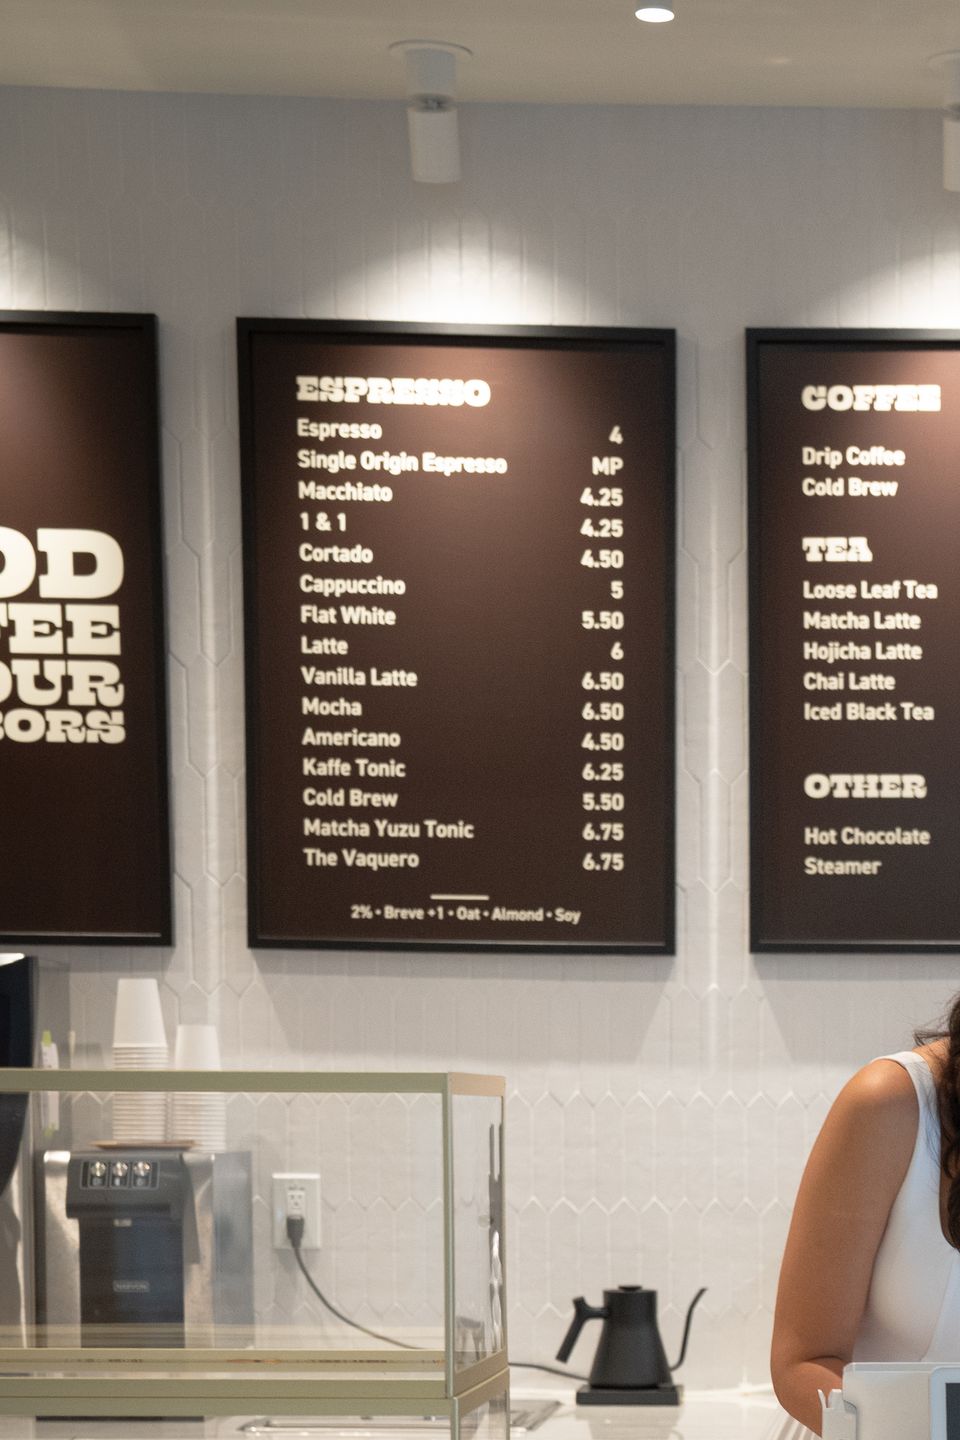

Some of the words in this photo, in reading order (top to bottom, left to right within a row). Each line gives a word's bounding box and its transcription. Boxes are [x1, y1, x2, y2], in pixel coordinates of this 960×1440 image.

[297, 376, 492, 408] ESPRESSO
[802, 384, 942, 411] COFFEE
[297, 418, 383, 442] Espresso
[609, 426, 623, 444] 4
[297, 449, 357, 474] Single
[359, 450, 420, 476] Origin
[421, 451, 509, 478] Espresso
[591, 456, 624, 476] MP
[802, 446, 843, 470] Drip
[845, 446, 907, 467] Coffee
[298, 481, 394, 503] Macchiato
[802, 477, 845, 497] Cold
[847, 476, 899, 497] Brew
[579, 487, 624, 507] 4.25
[300, 512, 309, 531] 1
[315, 511, 332, 531] &
[336, 512, 347, 532] 1
[580, 518, 624, 538] 4.25
[299, 543, 374, 564] Cortado
[580, 549, 624, 569] 4.50
[802, 536, 874, 563] TEA
[300, 574, 406, 598] Cappuccino
[610, 580, 624, 600] 5
[803, 580, 858, 599] Loose
[860, 579, 902, 600] Leaf
[902, 579, 939, 600] Tea
[300, 604, 337, 624] Flat
[340, 605, 397, 626] White
[581, 610, 624, 630] 5.50
[803, 611, 871, 630] Matcha
[873, 610, 922, 630] Latte
[0, 603, 121, 655] EE
[301, 635, 349, 655] Latte
[610, 642, 624, 660] 6
[803, 641, 872, 664] Hojicha
[875, 641, 923, 660] Latte
[0, 659, 124, 707] UR
[301, 666, 366, 686] Vanilla
[370, 667, 418, 687] Latte
[581, 672, 624, 691] 6.50
[803, 672, 845, 690] Chai
[848, 672, 896, 691] Latte
[302, 697, 362, 716] Mocha
[581, 702, 624, 721] 6.50
[804, 702, 842, 721] Iced
[846, 702, 897, 721] Black
[900, 702, 935, 721] Tea
[0, 708, 126, 744] ORS
[302, 727, 401, 747] Americano
[581, 732, 624, 751] 4.50
[303, 758, 351, 776] Kaffe
[355, 758, 406, 778] Tonic
[582, 763, 624, 781] 6.25
[804, 773, 927, 799] OTHER
[303, 788, 345, 806] Cold
[349, 789, 398, 807] Brew
[583, 792, 624, 811] 5.50
[304, 818, 370, 837] Matcha
[374, 819, 420, 838] Yuzu
[424, 820, 474, 839] Tonic
[582, 823, 624, 841] 6.75
[804, 827, 838, 845] Hot
[841, 827, 931, 845] Chocolate
[303, 848, 338, 866] The
[342, 849, 419, 871] Vaquero
[582, 853, 624, 871] 6.75
[805, 857, 882, 875] Steamer
[351, 905, 373, 919] 2%
[384, 905, 424, 920] Breve
[456, 906, 481, 920] Oat
[491, 907, 544, 922] Almond
[555, 908, 581, 924] Soy
